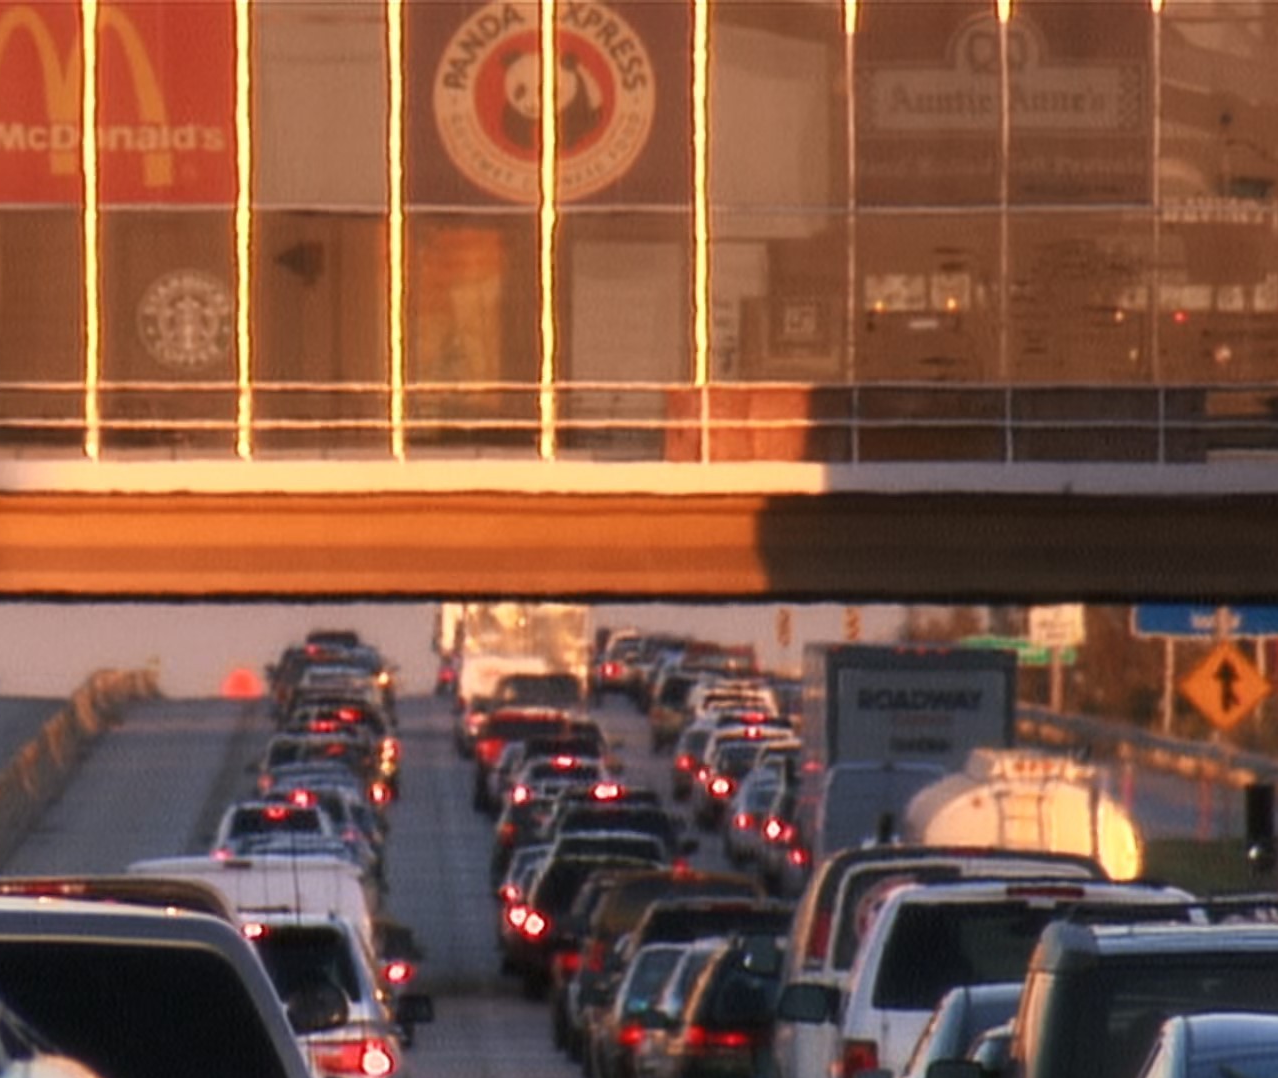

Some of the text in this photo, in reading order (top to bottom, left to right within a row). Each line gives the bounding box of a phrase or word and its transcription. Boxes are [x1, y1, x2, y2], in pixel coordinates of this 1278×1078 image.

[443, 0, 647, 91] PANDA XPRESS
[857, 688, 984, 711] ROADWAY
